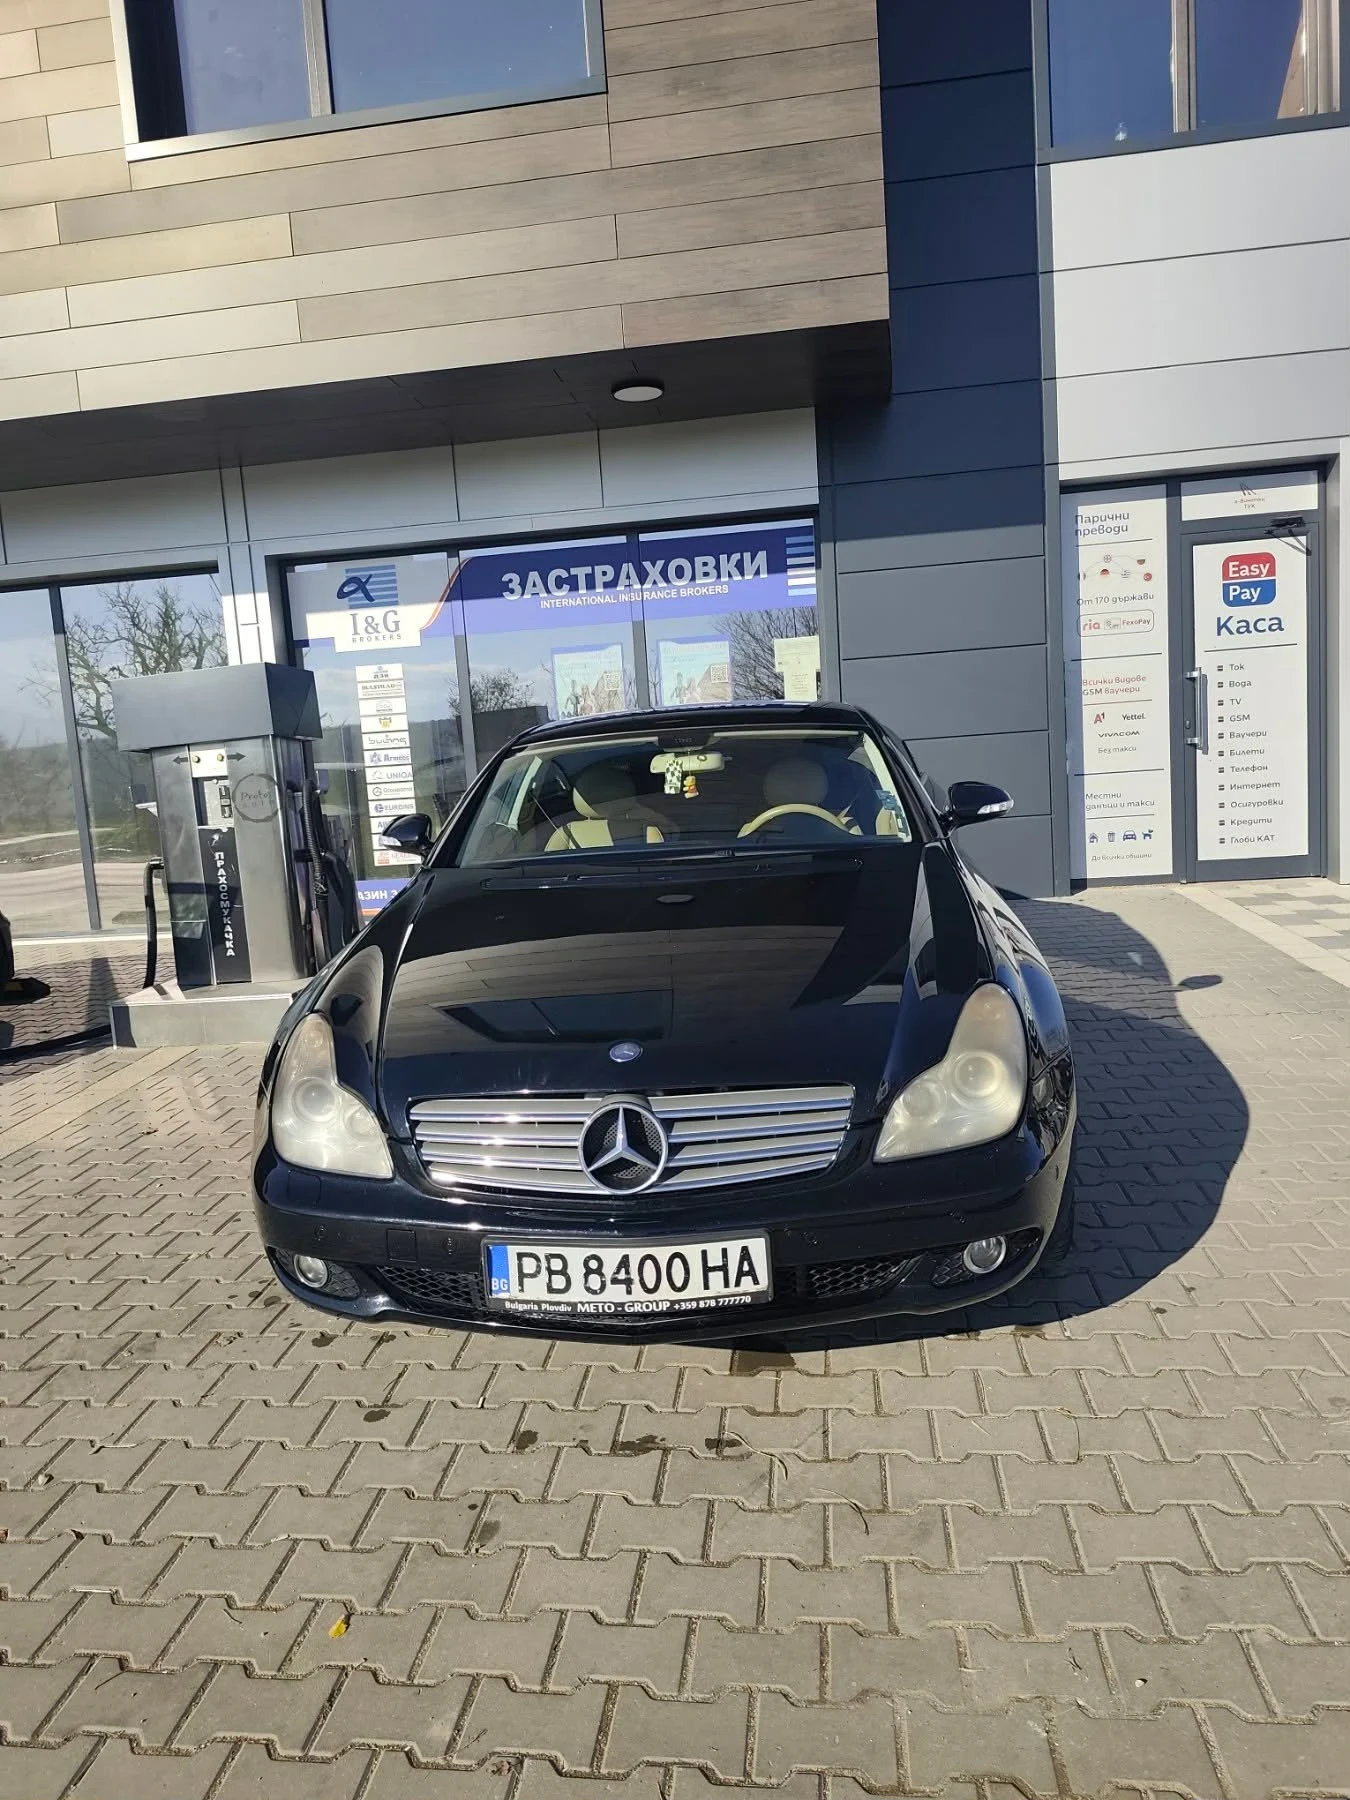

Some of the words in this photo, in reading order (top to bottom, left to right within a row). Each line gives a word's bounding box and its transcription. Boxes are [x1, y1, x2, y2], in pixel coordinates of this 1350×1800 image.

[1074, 512, 1130, 526] Парични
[1074, 524, 1129, 538] преводи
[1228, 560, 1270, 579] Easy
[501, 550, 767, 602] ЗАСТРАХОВКИ
[540, 594, 617, 610] INTERNATIONAL
[619, 588, 677, 604] INSURANCE
[680, 584, 728, 600] BROKERS
[1095, 596, 1110, 605] 170
[1111, 592, 1154, 605] държави
[1229, 585, 1261, 603] Pay
[1217, 615, 1284, 636] Каса
[352, 633, 402, 644] BROKERS
[1229, 663, 1245, 671] Ток
[1229, 680, 1252, 688] Вода
[1082, 688, 1103, 696] GSM
[1229, 698, 1242, 706] TV
[1229, 713, 1251, 723] GSM
[1229, 730, 1267, 740] Ваучери
[1229, 749, 1265, 757] Билети
[1229, 764, 1268, 774] Телефон
[1230, 781, 1281, 791] Интернет
[1126, 800, 1155, 808] такси
[1230, 799, 1284, 809] Осигуровки
[1230, 817, 1273, 827] Кредити
[1230, 836, 1256, 845] Глоби
[1256, 834, 1275, 843] КАТ
[214, 851, 236, 957] ПРАХОСМУКАЧКА
[516, 1252, 572, 1295] PB
[583, 1251, 691, 1295] 8400
[701, 1245, 760, 1291] HA
[491, 1278, 509, 1291] BG
[505, 1301, 539, 1312] Bulgaria
[541, 1303, 572, 1312] Plovdiv
[577, 1303, 615, 1314] METO
[624, 1301, 671, 1313] GROUP
[673, 1300, 698, 1311] +359
[699, 1299, 717, 1308] 878
[718, 1295, 752, 1306] 777770
